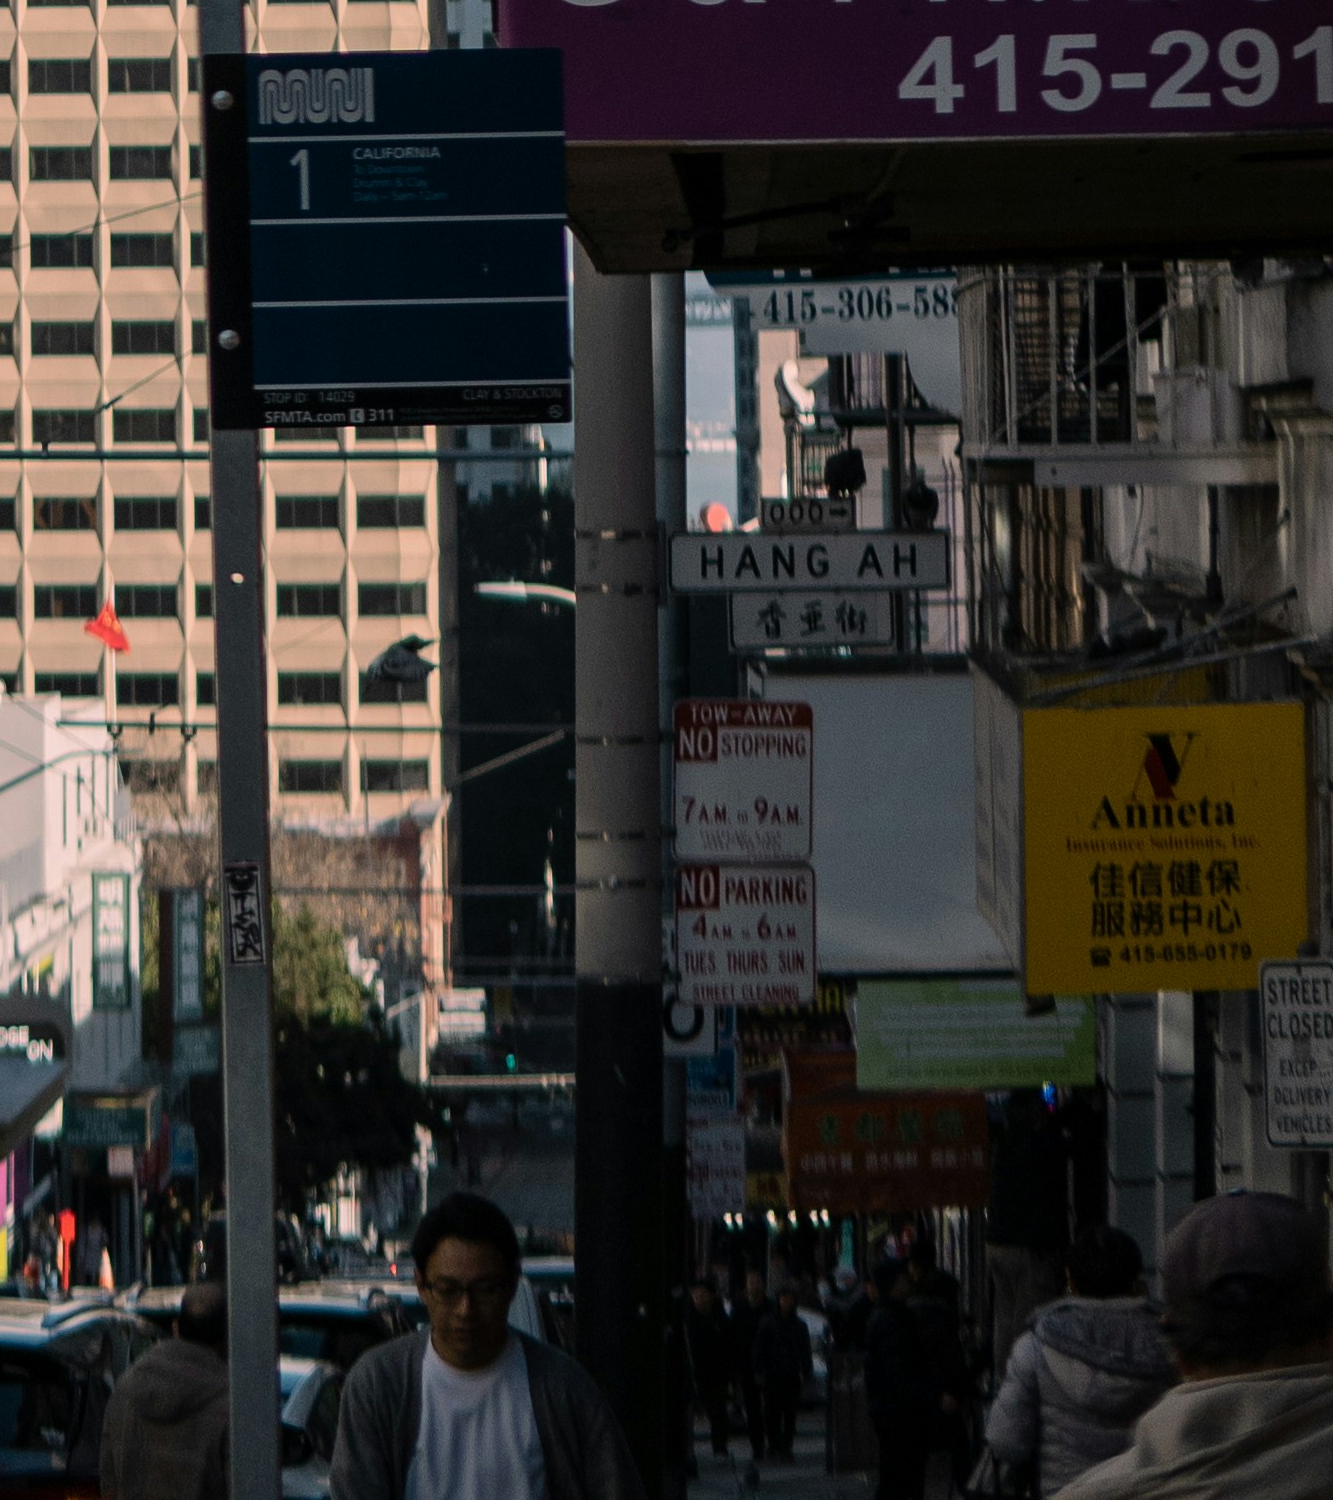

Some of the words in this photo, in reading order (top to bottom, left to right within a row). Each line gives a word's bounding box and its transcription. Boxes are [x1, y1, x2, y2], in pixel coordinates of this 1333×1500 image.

[289, 149, 311, 211] 1
[353, 146, 441, 160] CALIFORNIA
[264, 392, 292, 405] STOP
[461, 388, 491, 401] CLAY
[493, 387, 502, 399] &
[505, 386, 563, 400] STOCKTON
[264, 409, 347, 425] SFMTA.com
[368, 407, 395, 422] 311
[700, 542, 830, 580] HANG
[857, 542, 918, 579] AH
[690, 703, 798, 726] TOW-AWAY
[679, 726, 714, 760] NO
[720, 732, 807, 760] STOPPING
[1090, 794, 1235, 830] Anneta
[1066, 835, 1144, 852] Insurance
[680, 865, 716, 906] NO
[723, 874, 808, 906] PARKING
[684, 949, 717, 975] TUES
[726, 949, 768, 975] THURS
[777, 950, 805, 975] SUN
[1266, 976, 1333, 1006] STREET
[1273, 1085, 1333, 1105] DELIVERY
